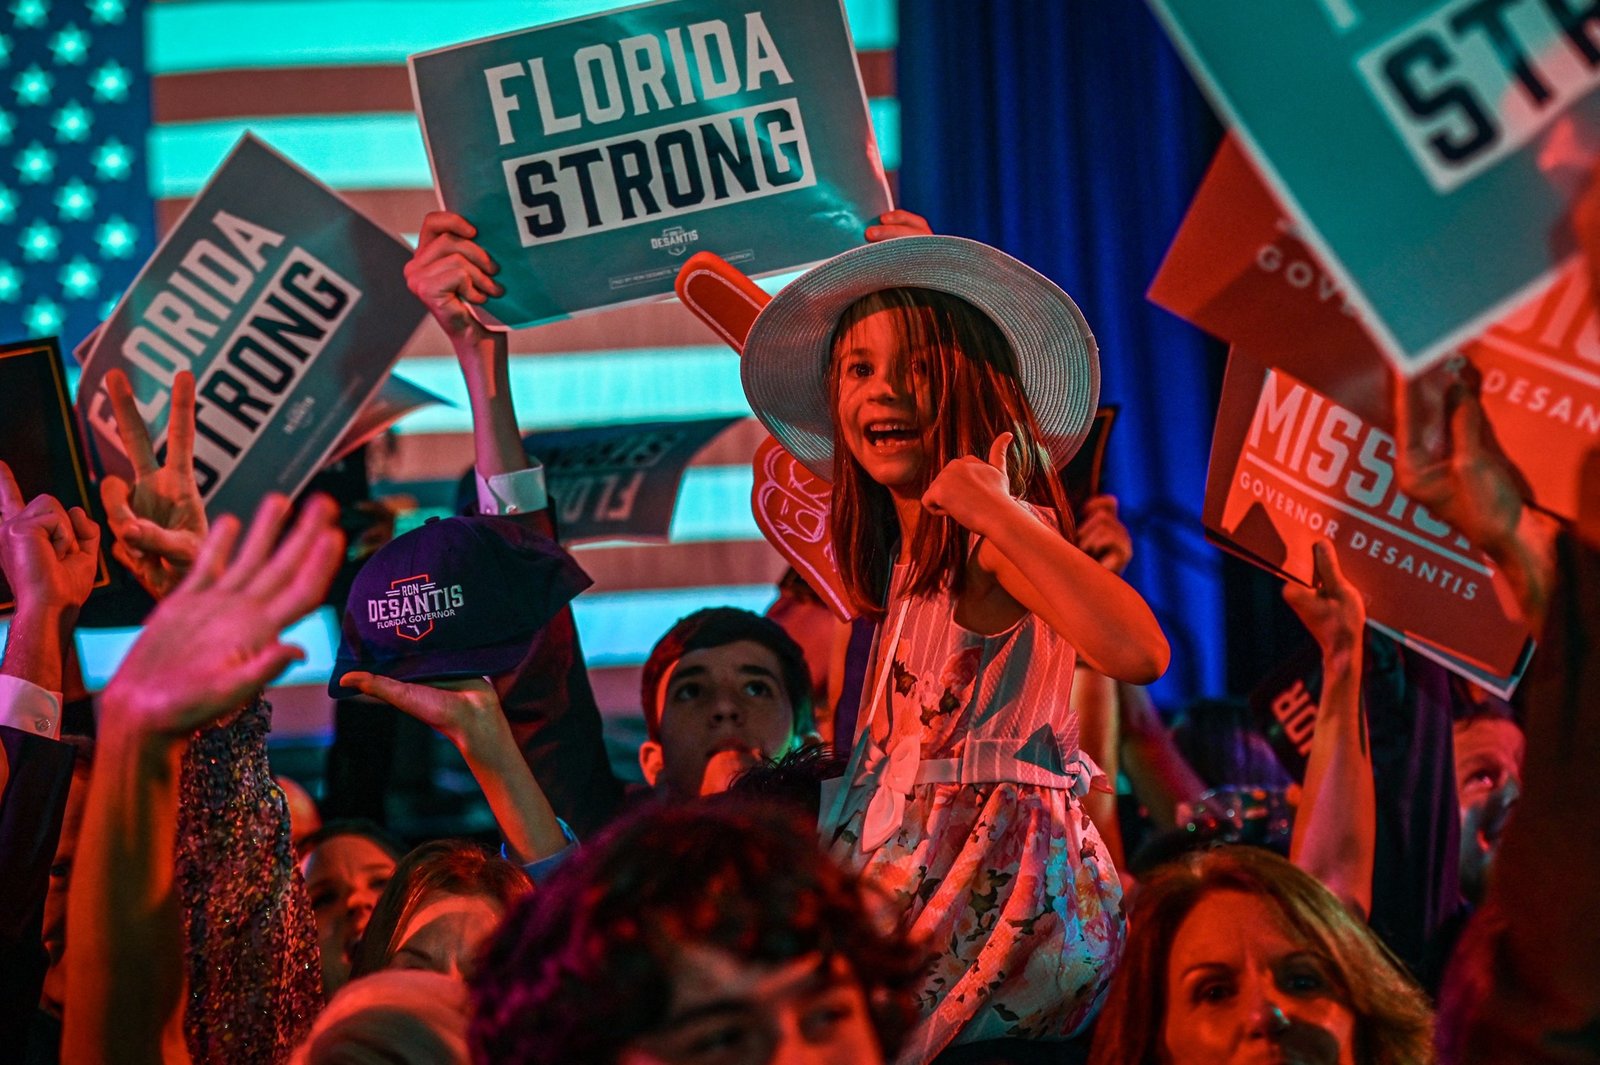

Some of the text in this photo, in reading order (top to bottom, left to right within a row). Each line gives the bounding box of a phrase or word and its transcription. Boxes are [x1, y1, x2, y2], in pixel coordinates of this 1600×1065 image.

[484, 11, 794, 145] FLORIDA
[515, 107, 804, 238] STRONG
[1248, 368, 1471, 550] MISS
[401, 583, 420, 597] RON
[1240, 471, 1477, 601] GOVERNOR DESANTIS
[368, 584, 464, 622] DESANTIS
[377, 608, 455, 630] FLORIDA GOVERNOR
